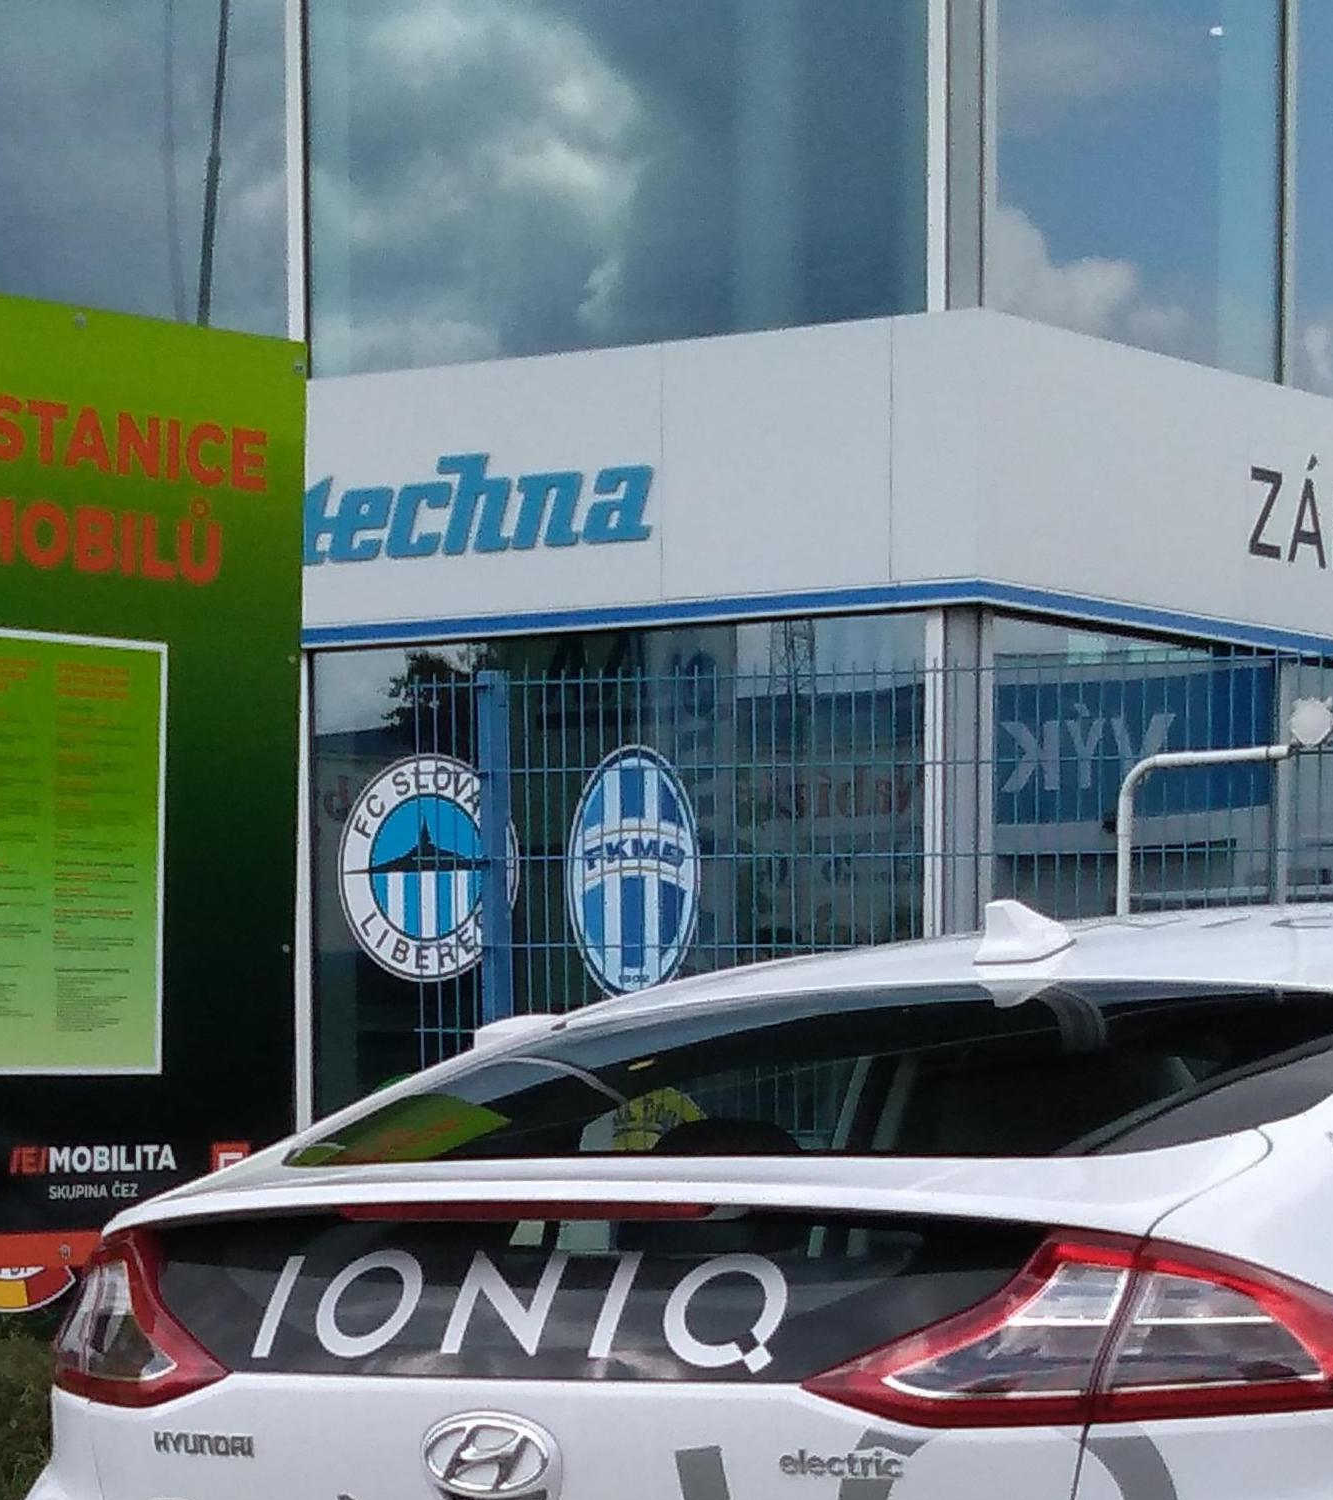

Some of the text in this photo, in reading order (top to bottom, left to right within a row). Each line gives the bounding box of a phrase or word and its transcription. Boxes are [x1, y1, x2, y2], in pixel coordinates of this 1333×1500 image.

[353, 765, 482, 840] FC SLOVA
[359, 909, 483, 970] LIBERE
[48, 1180, 139, 1200] SKUPINA ČEZ
[251, 1248, 790, 1374] IONIQ
[153, 1431, 256, 1459] HYUNDAI
[779, 1448, 904, 1481] electric
